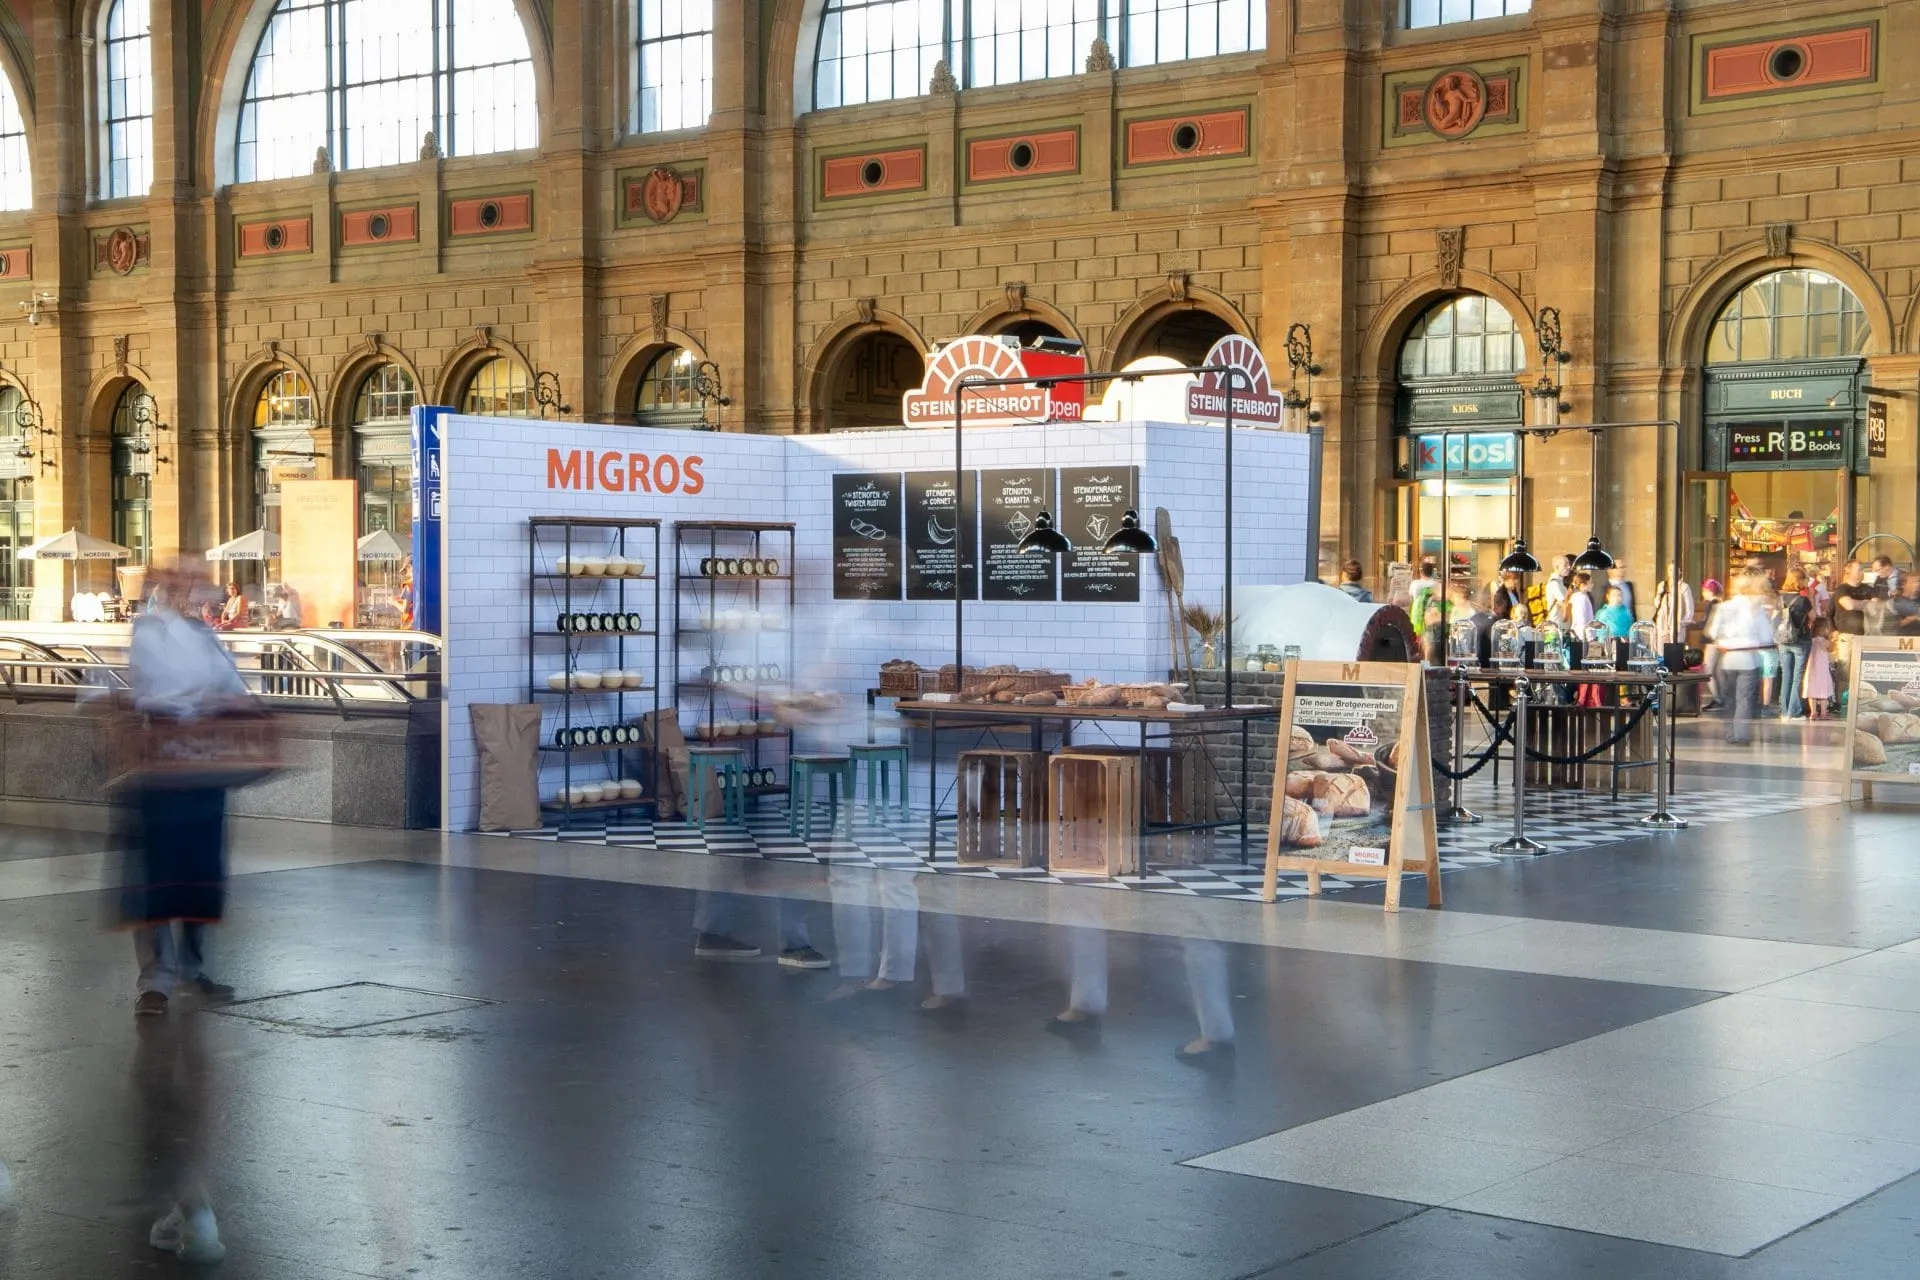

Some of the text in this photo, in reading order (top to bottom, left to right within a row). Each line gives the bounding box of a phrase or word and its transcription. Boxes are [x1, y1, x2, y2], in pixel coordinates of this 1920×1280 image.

[1770, 388, 1803, 399] BUCH
[1452, 404, 1478, 413] KIOSK
[1734, 432, 1760, 443] Press
[1808, 441, 1841, 451] Books
[547, 448, 704, 495] MIGROS
[1004, 496, 1030, 504] CIABATTA
[1085, 494, 1111, 503] DUNKEL
[1899, 637, 1914, 650] M
[1342, 663, 1360, 681] M
[1336, 700, 1394, 710] Brotgeneration
